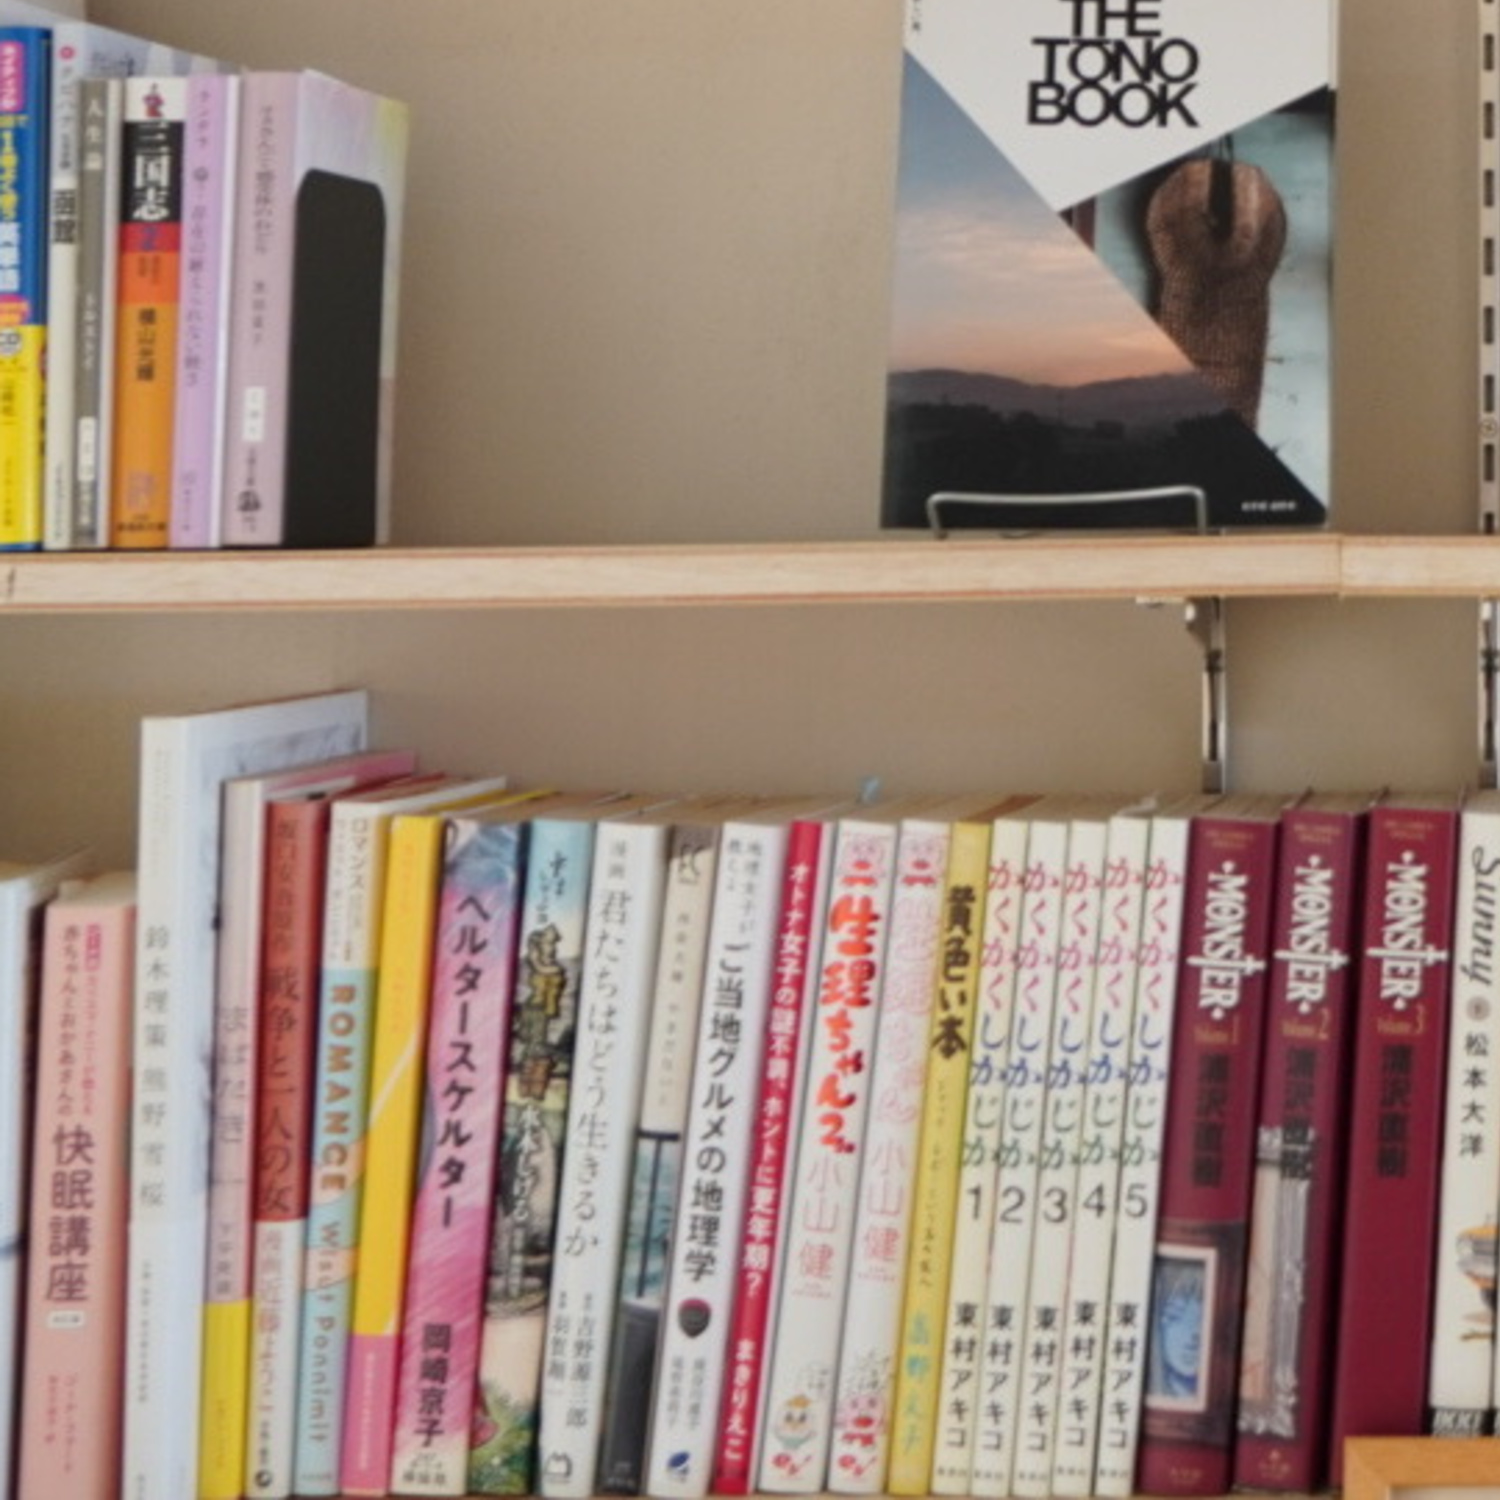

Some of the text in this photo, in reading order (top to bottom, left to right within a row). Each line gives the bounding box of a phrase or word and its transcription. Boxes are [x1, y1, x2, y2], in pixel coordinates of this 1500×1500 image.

[1026, 81, 1201, 128] BOOK
[1030, 36, 1200, 86] TONO
[84, 100, 103, 172] 人生論
[132, 124, 172, 222] 三国志
[136, 306, 156, 382] 横山光輝
[142, 926, 171, 1052] 鈴木理策
[932, 883, 976, 1060] 黄色い本
[1186, 872, 1267, 1012] MONSTER
[1274, 863, 1349, 1006] MONSTER
[1366, 862, 1448, 1003] MONSTER
[260, 968, 301, 1216] 戦争と一人の女
[322, 985, 357, 1192] ROMANCE
[436, 894, 491, 1228] ヘルタースケルター
[562, 890, 630, 1260] 君たちはどう生きるか
[963, 858, 1026, 1221] かくかくしかじか 1
[1000, 861, 1060, 1224] かくかくしかじか 2
[1042, 862, 1105, 1224] かくかくしかじか 3
[1082, 857, 1144, 1220] かくかくしかじか 4
[1118, 858, 1185, 1221] かくかくしかじか 5
[1459, 1033, 1489, 1159] 松本大洋
[512, 1104, 540, 1222] 水木しげる
[681, 940, 749, 1281] ご当地グルメの地理学
[1193, 1052, 1229, 1189] 浦沢直樹
[1280, 1046, 1318, 1181] 浦沢直樹
[1378, 1043, 1412, 1179] 浦沢直樹
[44, 1121, 97, 1304] 快眠講座
[801, 1156, 843, 1279] 小山健
[865, 1140, 908, 1263] 小山健
[308, 1315, 338, 1443] Ponnimit
[414, 1322, 453, 1448] 岡崎京子
[566, 1315, 593, 1428] 吉野源三郎
[724, 1337, 757, 1461] まきりえこ
[945, 1303, 977, 1450] 東村アキコ
[985, 1304, 1015, 1451] 東村アキコ
[1026, 1305, 1058, 1453] 東村アキコ
[1064, 1302, 1097, 1449] 東村アキコ
[1106, 1302, 1139, 1449] 東村アキコ
